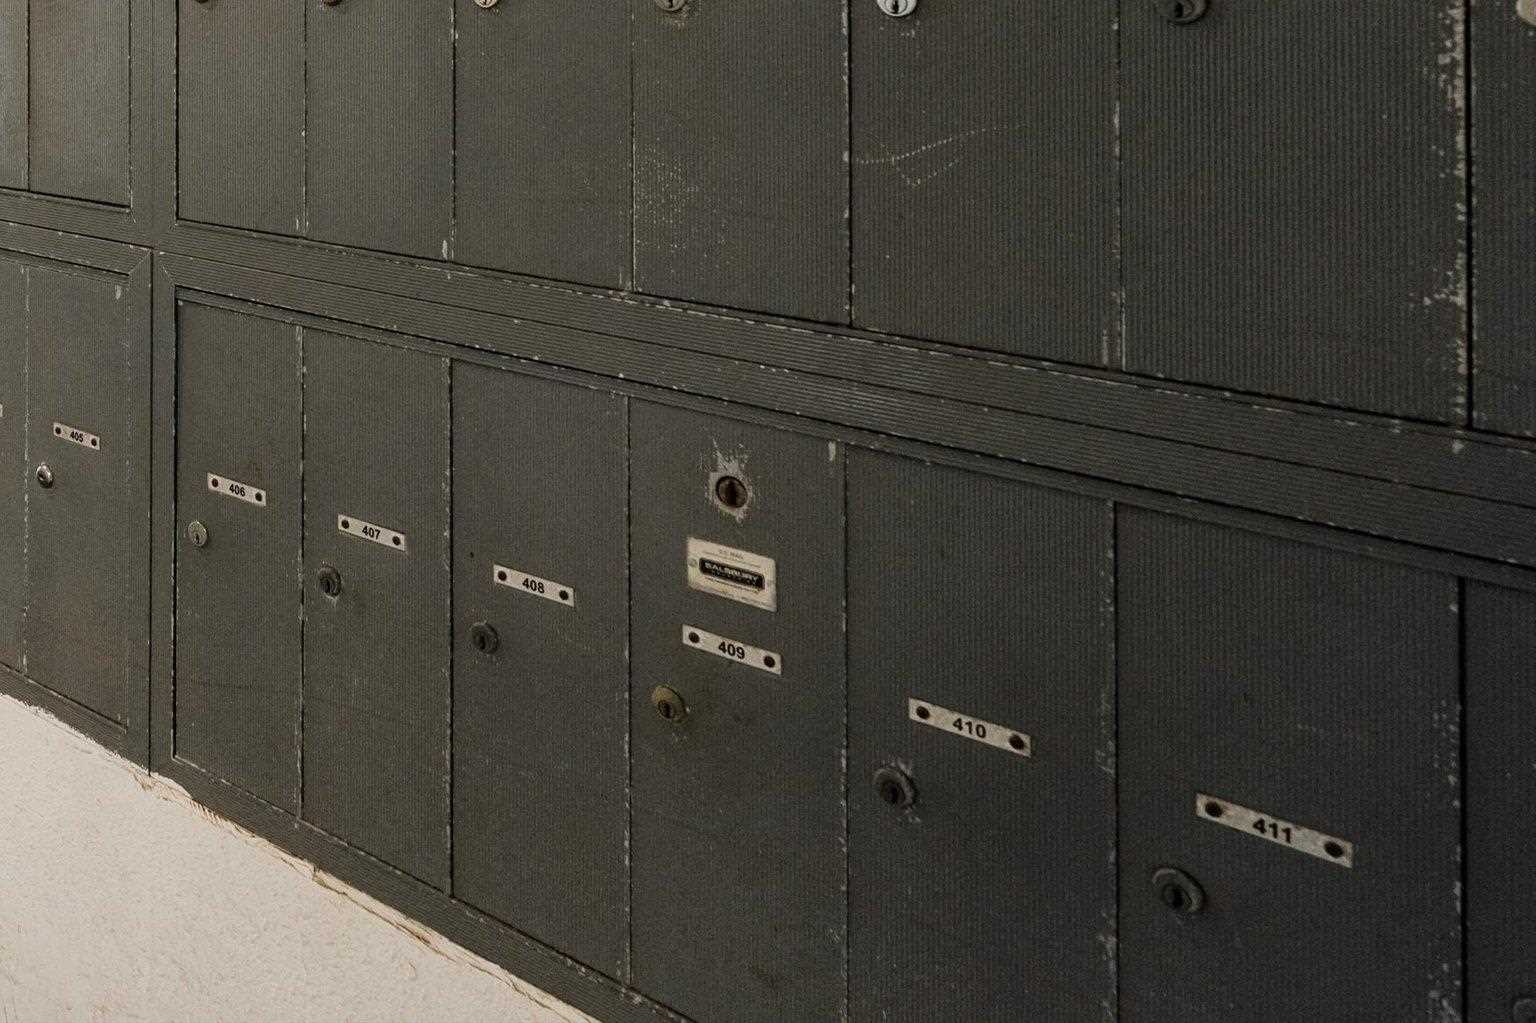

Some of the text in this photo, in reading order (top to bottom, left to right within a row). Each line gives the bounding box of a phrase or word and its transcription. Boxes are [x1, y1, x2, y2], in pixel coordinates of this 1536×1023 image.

[69, 430, 84, 443] 405
[228, 482, 246, 498] 406
[361, 525, 381, 541] 407
[522, 577, 545, 594] 408
[718, 641, 746, 660] 409
[952, 717, 987, 739] 410
[1252, 817, 1292, 844] 411
